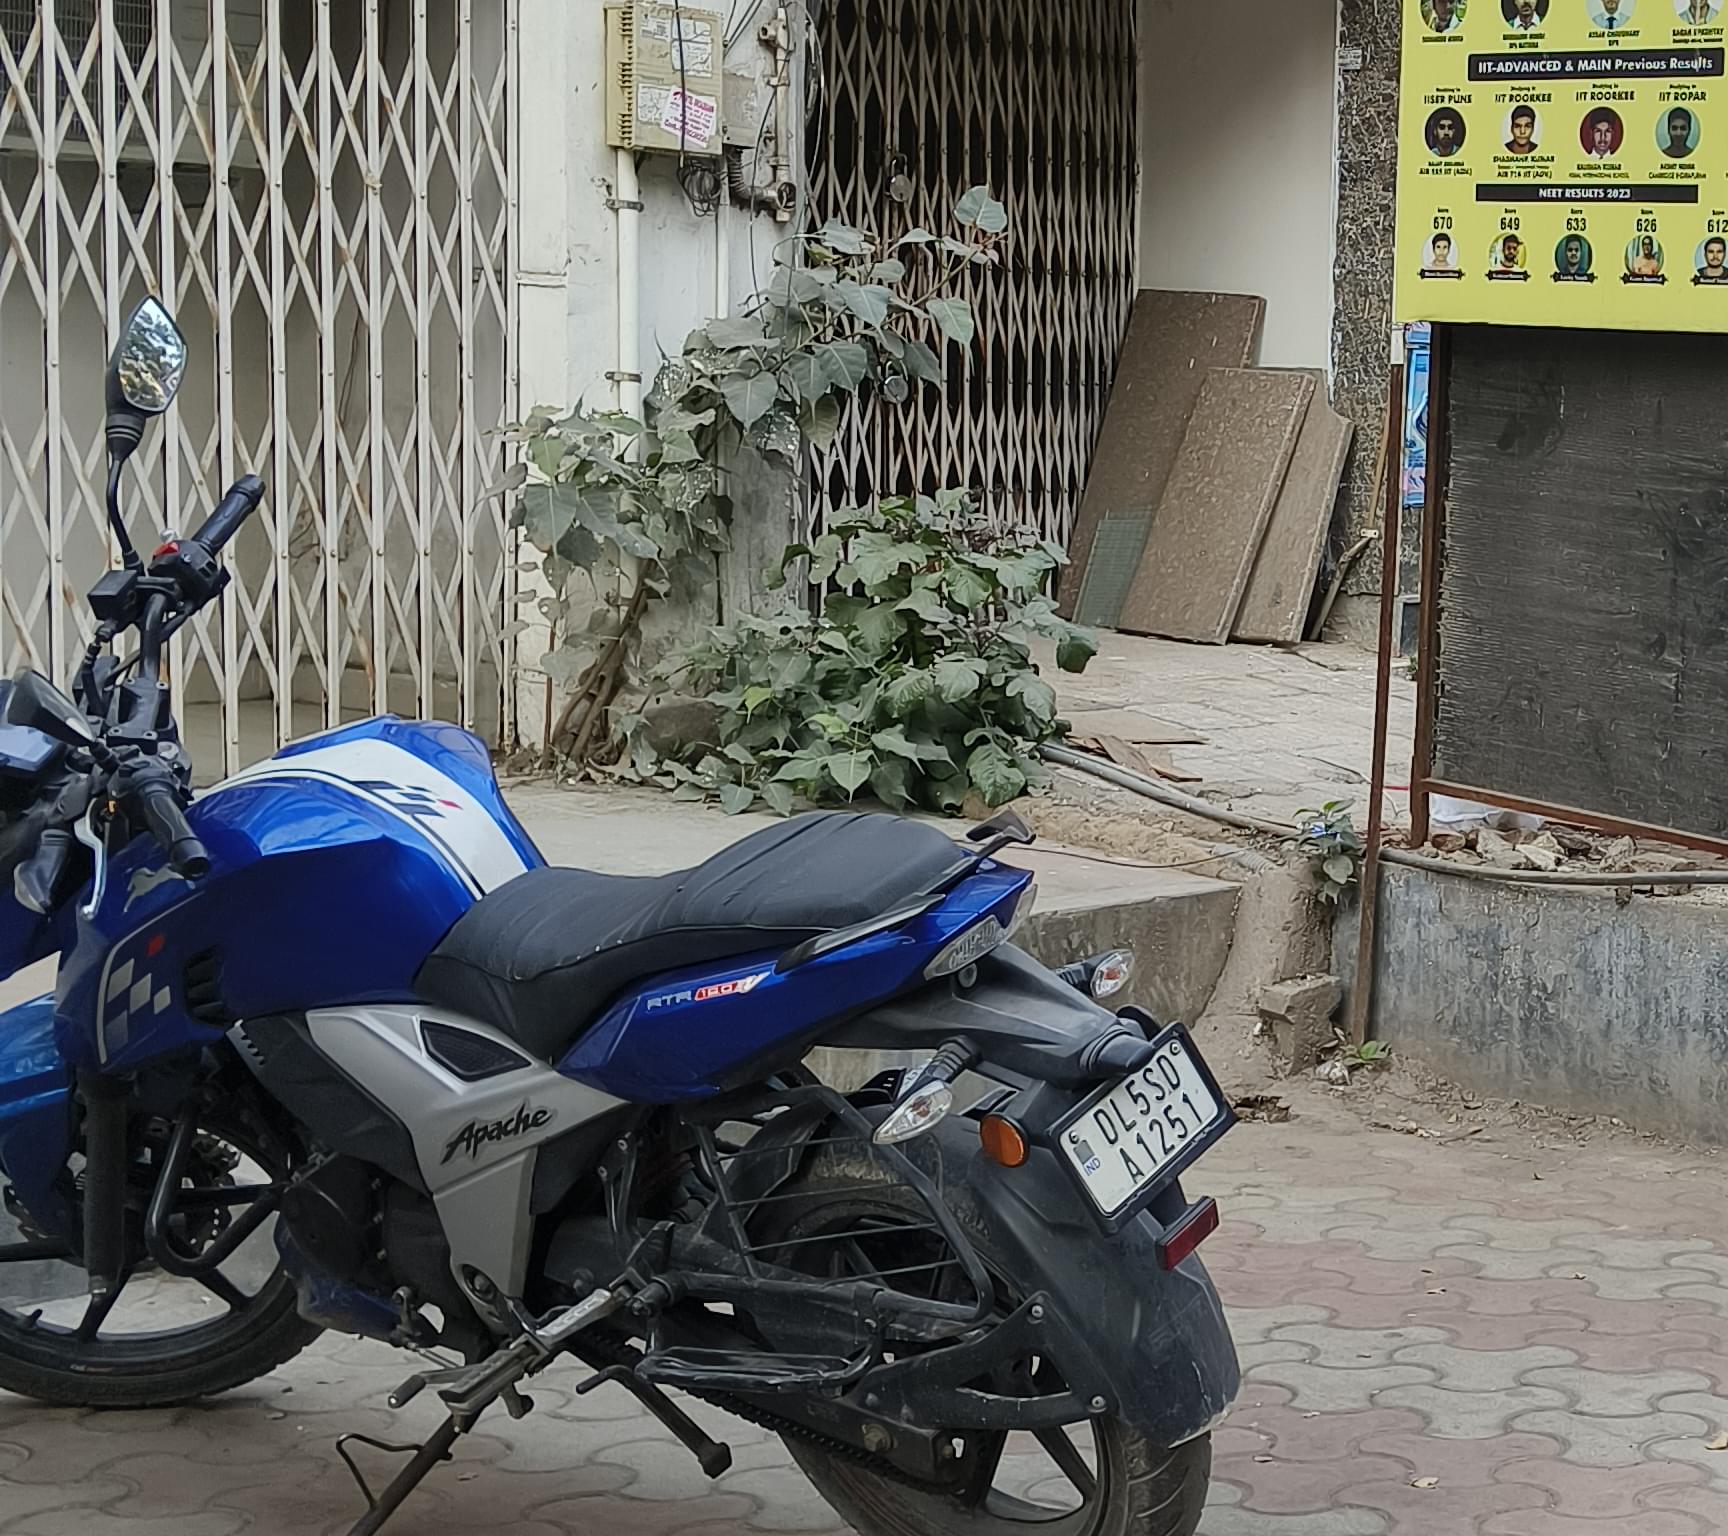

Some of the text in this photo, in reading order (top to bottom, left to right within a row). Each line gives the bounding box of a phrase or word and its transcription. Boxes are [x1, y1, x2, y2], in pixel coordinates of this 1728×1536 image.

[1478, 60, 1562, 76] IIT-ADVANCED
[1565, 59, 1574, 72] &
[1577, 57, 1612, 72] MAIN
[1614, 57, 1666, 72] Previous
[1673, 91, 1707, 101] ROPAR
[1539, 188, 1563, 199] NEET
[1607, 188, 1631, 199] 2023
[1433, 216, 1453, 231] 670
[1500, 217, 1520, 231] 649
[1566, 217, 1587, 232] 633
[1636, 218, 1657, 233] 626
[1707, 219, 1728, 234] 612
[440, 1101, 553, 1164] Apache
